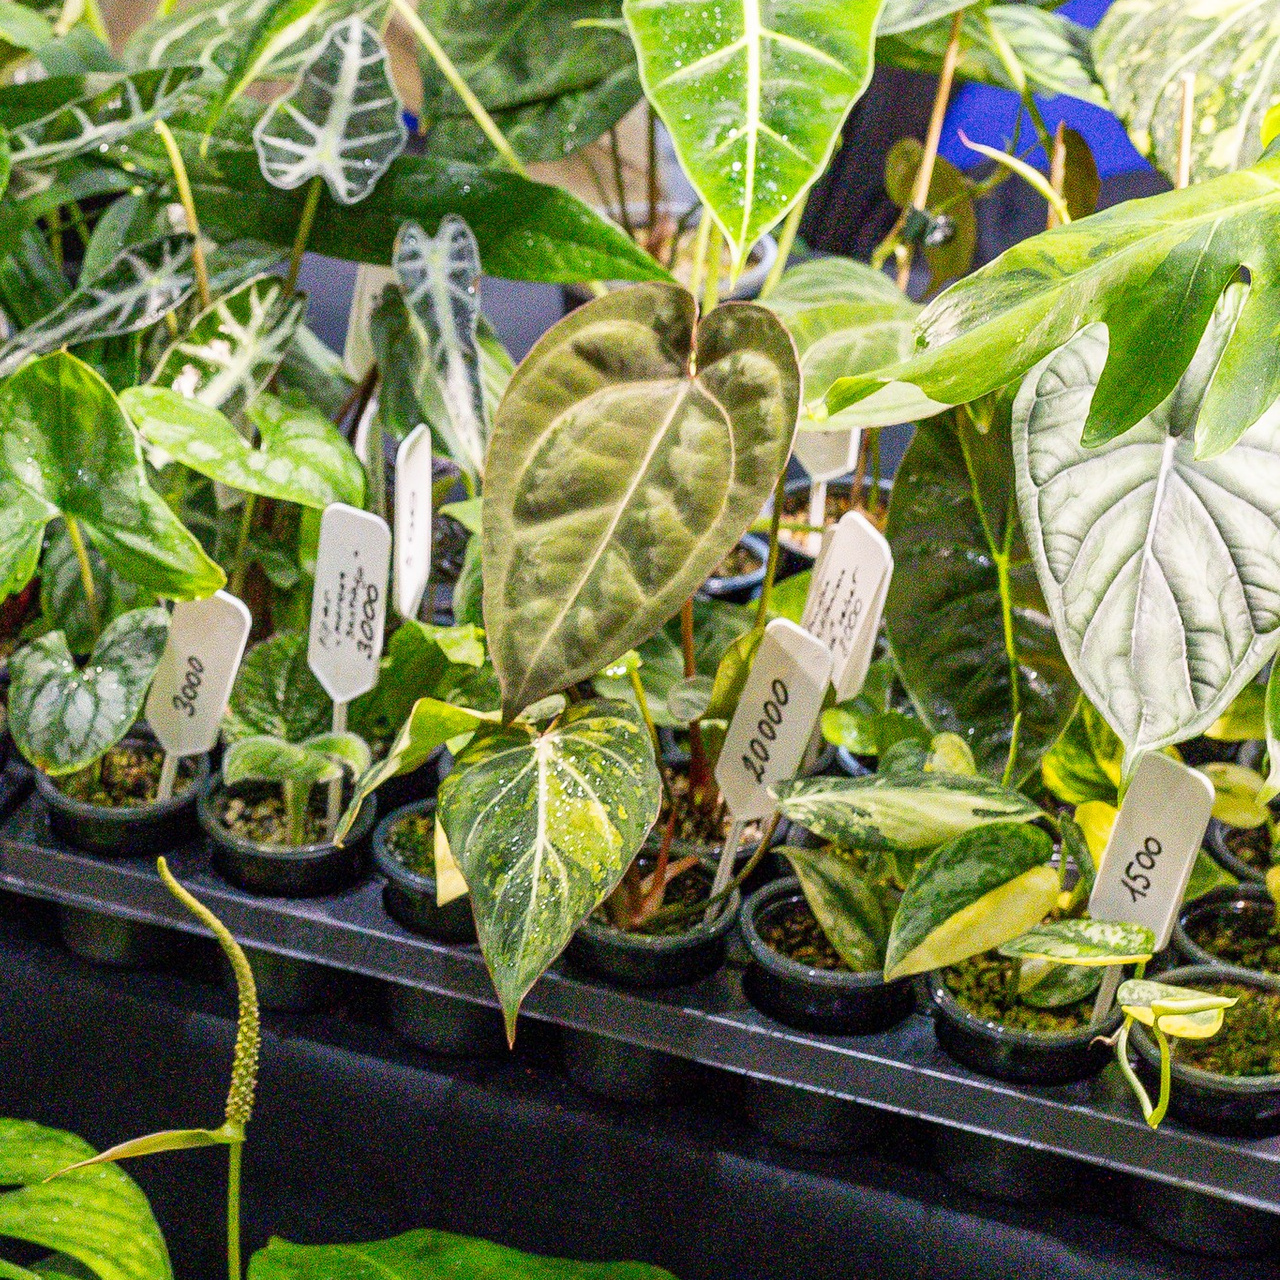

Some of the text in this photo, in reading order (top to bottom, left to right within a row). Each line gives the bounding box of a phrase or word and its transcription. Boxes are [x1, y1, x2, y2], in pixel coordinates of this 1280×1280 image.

[357, 583, 379, 660] 3000
[173, 655, 203, 718] 3000
[742, 679, 788, 784] 20000
[1121, 836, 1161, 902] 1500
